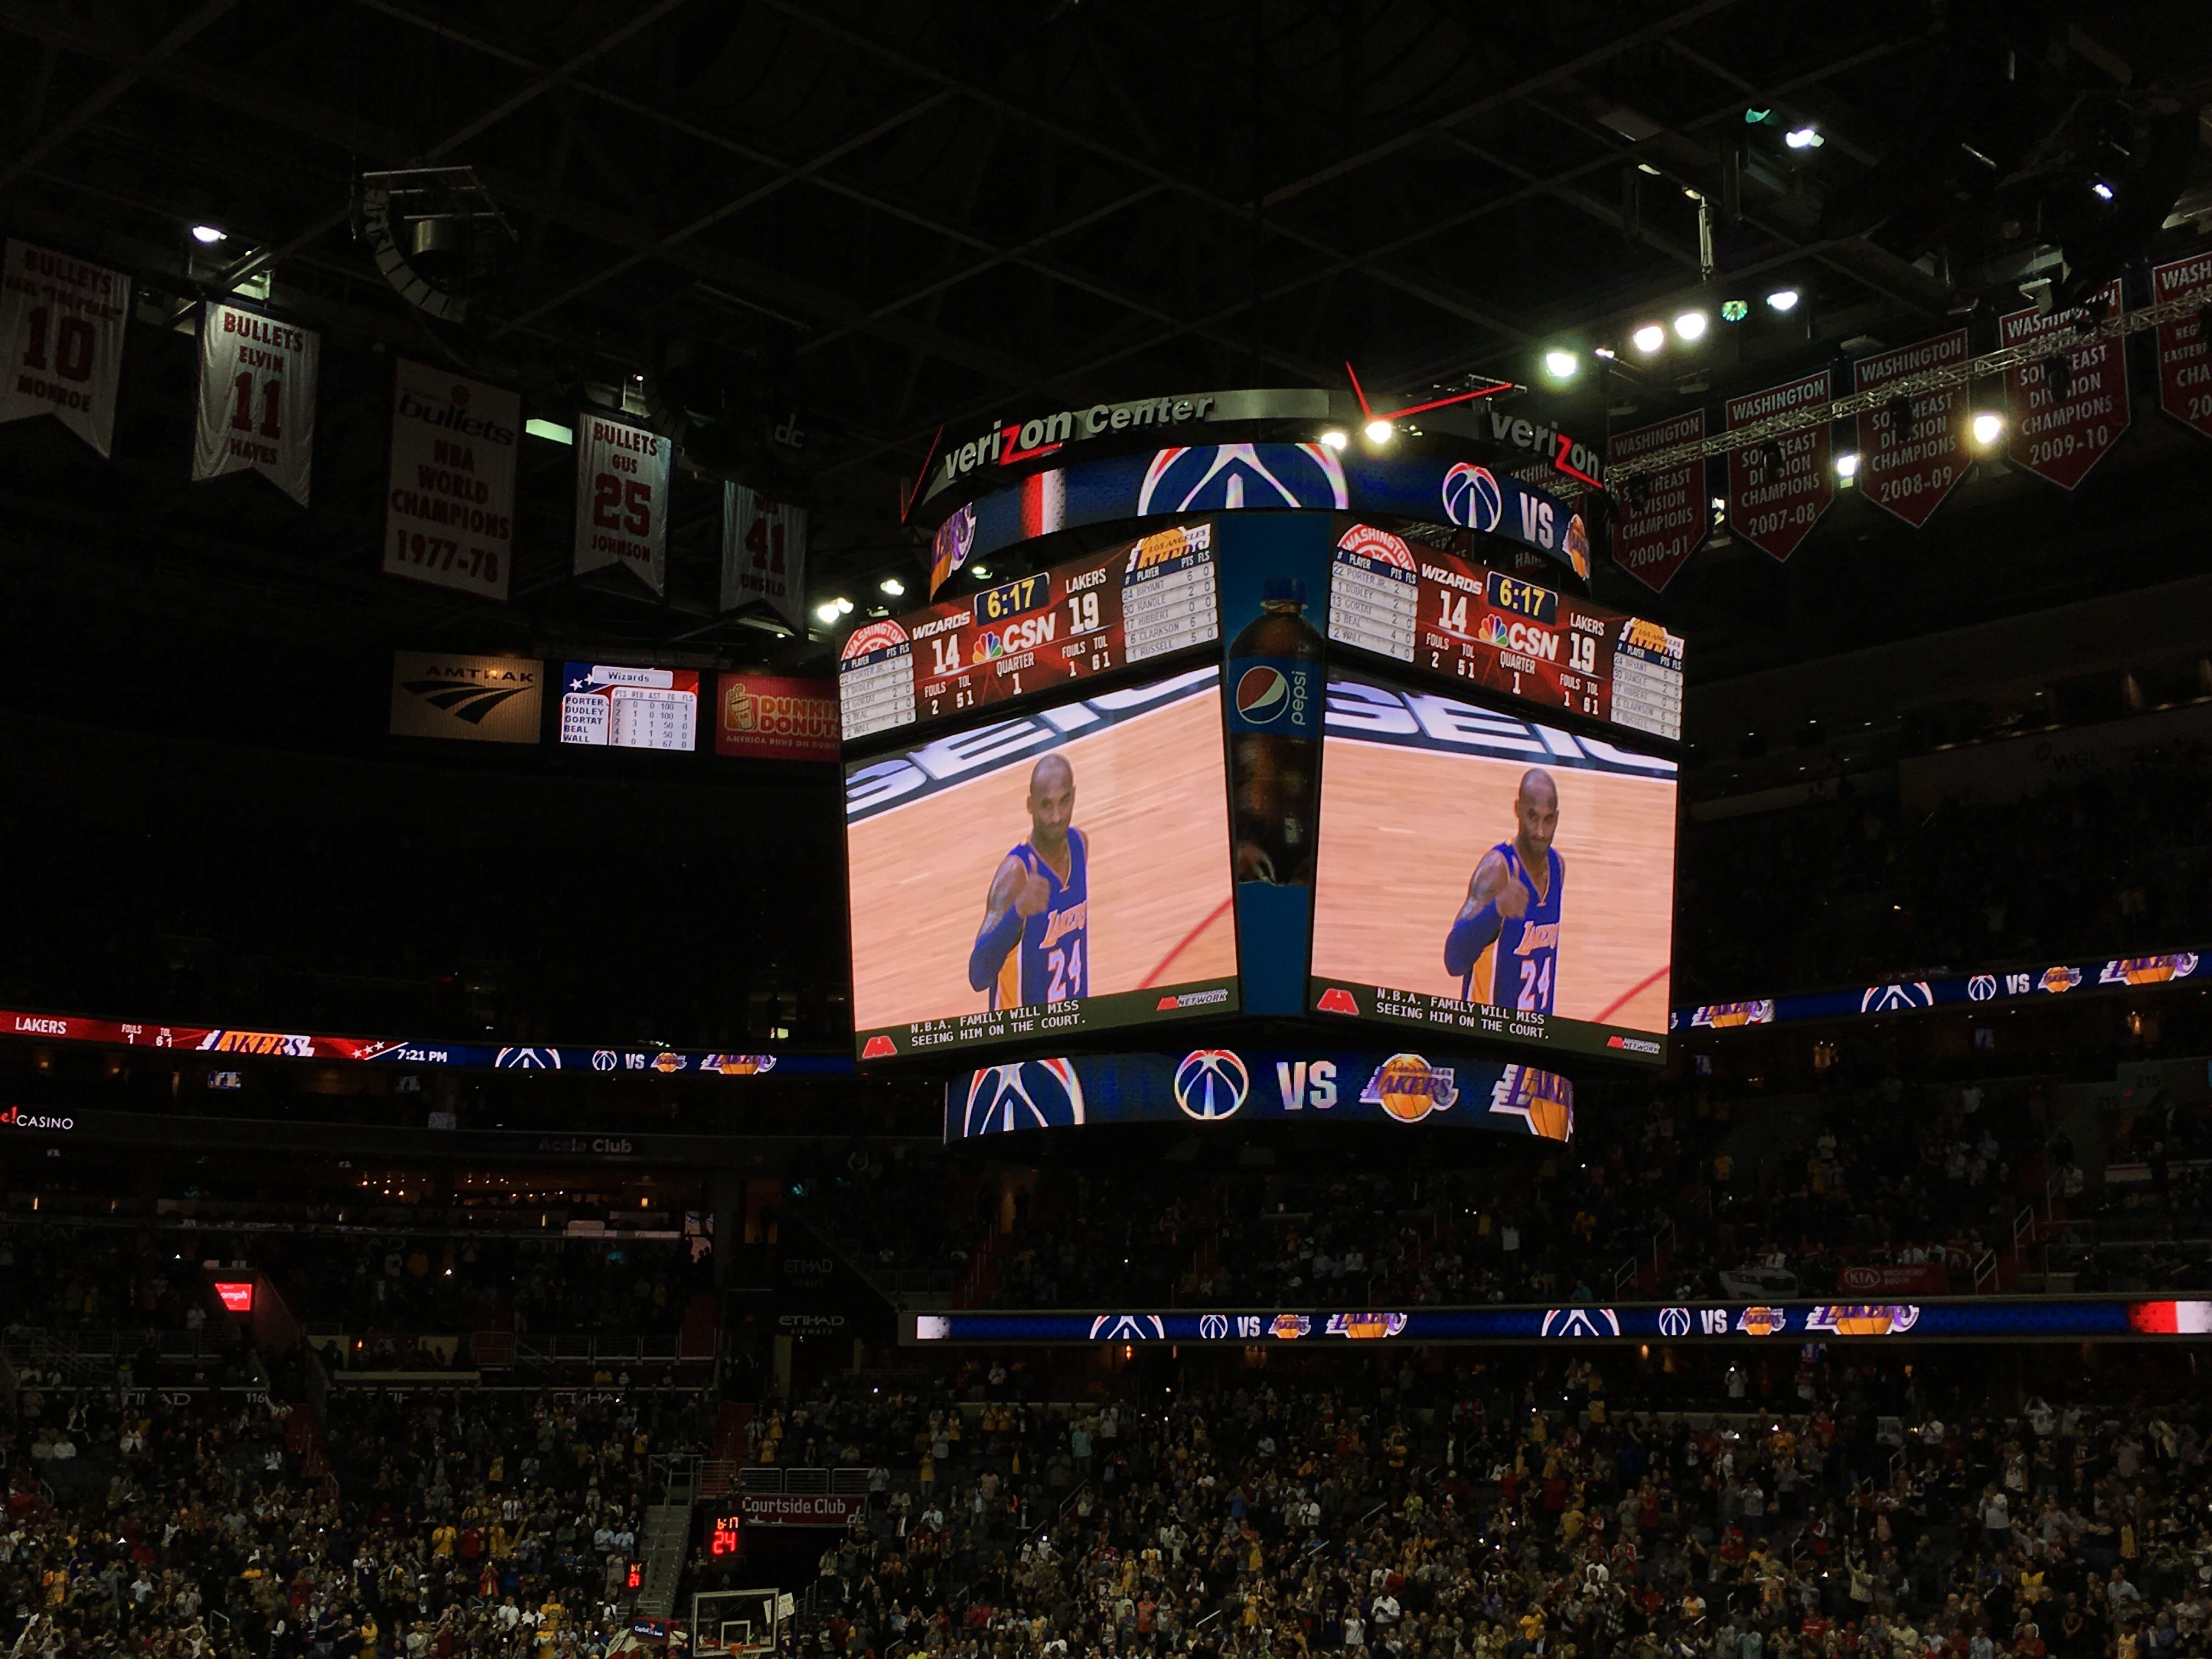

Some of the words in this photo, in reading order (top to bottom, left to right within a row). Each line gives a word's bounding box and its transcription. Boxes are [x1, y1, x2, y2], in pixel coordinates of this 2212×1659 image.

[25, 250, 112, 296] BULLETS
[24, 307, 94, 382] 10
[224, 312, 303, 353] BULLETS
[240, 346, 284, 373] ELVIN
[1861, 337, 1961, 382] WASHINGTON
[18, 375, 90, 413] MONROE
[232, 371, 281, 439] 11
[1733, 379, 1824, 421] WASHINGTON
[399, 393, 514, 445] bullets
[2022, 394, 2113, 435] CHAMPIONS
[594, 422, 657, 456] BULLETS
[945, 411, 1073, 482] verizon
[1086, 396, 1215, 434] Center
[1491, 411, 1603, 488] verizon
[1615, 416, 1700, 456] WASHINGTON
[2030, 425, 2109, 466] 2009-10
[230, 439, 278, 465] HAYES
[435, 440, 475, 472] NBA
[612, 454, 637, 474] GUS
[1872, 435, 1956, 472] CHAMPIONS
[418, 464, 488, 504] WORLD
[1741, 473, 1820, 508] CHAMPIONS
[1881, 466, 1953, 503] 2008-09
[392, 489, 509, 540] CHAMPIONS
[594, 472, 651, 538] 25
[1519, 491, 1554, 549] VS
[1622, 507, 1694, 540] CHAMPIONS
[1748, 503, 1816, 538] 2007-08
[592, 534, 651, 562] JOHNSON
[744, 518, 785, 574] 41
[1165, 528, 1207, 549] ANGELES
[1630, 535, 1689, 568] 2000-01
[398, 529, 498, 582] 1977-78
[1137, 566, 1160, 582] PLAYER
[1181, 557, 1194, 568] PTS
[1197, 550, 1210, 563] FLS
[1065, 567, 1107, 595] LAKERS
[1333, 562, 1344, 576] 22
[1347, 568, 1375, 586] PORTER
[1348, 554, 1371, 569] PLAYER
[1390, 567, 1402, 580] PTS
[1405, 572, 1417, 585] FLS
[1421, 563, 1483, 596] WIZARDS
[988, 579, 1035, 619] 6:17
[1122, 590, 1133, 601] 24
[1136, 581, 1165, 597] BRYANT
[1331, 595, 1342, 607] 13
[1346, 583, 1373, 600] DUDLEY
[1499, 578, 1546, 617] 6:17
[1068, 591, 1100, 636] 19
[1123, 605, 1134, 616] 30
[1137, 595, 1166, 611] RANDLE
[1438, 589, 1468, 634] 14
[912, 611, 971, 641] WIZARDS
[1002, 612, 1056, 654] CSN
[1125, 619, 1135, 629] 17
[1138, 610, 1170, 626] HIBBERT
[1139, 622, 1180, 641] CLARKSON
[1344, 613, 1361, 627] BEAL
[1570, 612, 1605, 637] LAKERS
[1062, 640, 1086, 659] FOULS
[1092, 635, 1109, 650] TOL
[1140, 640, 1173, 657] RUSSELL
[1343, 629, 1362, 644] WALL
[1426, 632, 1450, 651] FOULS
[1462, 643, 1475, 659] TOL
[1509, 622, 1560, 661] CSN
[851, 658, 870, 668] PLAYER
[887, 647, 897, 658] PTS
[932, 634, 960, 675] 14
[996, 652, 1035, 677] QUARTER
[1431, 651, 1440, 669] 2
[1500, 651, 1536, 675] QUARTER
[1569, 633, 1596, 673] 19
[426, 665, 535, 683] AMTRAK
[608, 672, 650, 682] Wizards
[840, 674, 849, 685] 22
[851, 668, 874, 681] PORTER
[1069, 661, 1076, 676] 1
[614, 690, 627, 698] PTS
[924, 680, 947, 698] FOULS
[957, 674, 972, 688] TOL
[1012, 673, 1022, 696] 1
[1513, 672, 1521, 695] 1
[1559, 673, 1581, 691] FOULS
[1587, 681, 1599, 696] TOL
[565, 697, 603, 707] PORTER
[565, 706, 604, 715] DUDLEY
[842, 701, 850, 711] 13
[931, 699, 939, 715] 2
[1291, 670, 1308, 726] pepsi
[563, 734, 590, 743] WALL
[564, 725, 589, 733] BEAL
[1047, 938, 1082, 1003] 24
[1517, 956, 1551, 1011] 24
[2006, 973, 2030, 995] VS
[1178, 992, 1228, 1007] NETWORK
[1376, 988, 1421, 1005] N.B.A.
[1430, 996, 1476, 1014] FAMILY
[1481, 1005, 1510, 1019] WILL
[1516, 1011, 1545, 1025] MISS
[15, 1017, 67, 1035] LAKERS
[121, 1024, 142, 1034] FOULS
[911, 1019, 952, 1034] N.B.A.
[960, 1011, 1003, 1027] FAMILY
[1010, 1006, 1041, 1020] WILL
[1047, 1000, 1080, 1014] MISS
[911, 1031, 954, 1047] SEEING
[960, 1027, 983, 1040] HIM
[989, 1024, 1005, 1036] ON
[1011, 1020, 1034, 1034] THE
[1041, 1013, 1086, 1029] COURT.
[1376, 1002, 1423, 1019] SEEING
[1429, 1010, 1453, 1025] HIM
[1459, 1014, 1475, 1028] ON
[1481, 1018, 1503, 1032] THE
[1509, 1023, 1550, 1040] COURT.
[206, 1030, 306, 1056] LAKERS
[397, 1048, 425, 1062] 7:21
[428, 1051, 448, 1063] PM
[625, 1053, 645, 1070] VS
[1276, 1060, 1338, 1110] VS
[1366, 1066, 1453, 1107] LAKERS
[16, 1114, 74, 1130] CASINO
[591, 1138, 633, 1154] Club
[783, 1259, 834, 1274] ETIHAD
[1849, 1272, 1875, 1284] KIA
[778, 1314, 845, 1326] ETIHAD
[1237, 1316, 1261, 1338] VS
[1700, 1309, 1728, 1335] VS
[741, 1497, 811, 1515] Courtside
[814, 1498, 847, 1514] Club
[717, 1516, 739, 1530] 6:17
[713, 1530, 737, 1555] 24
